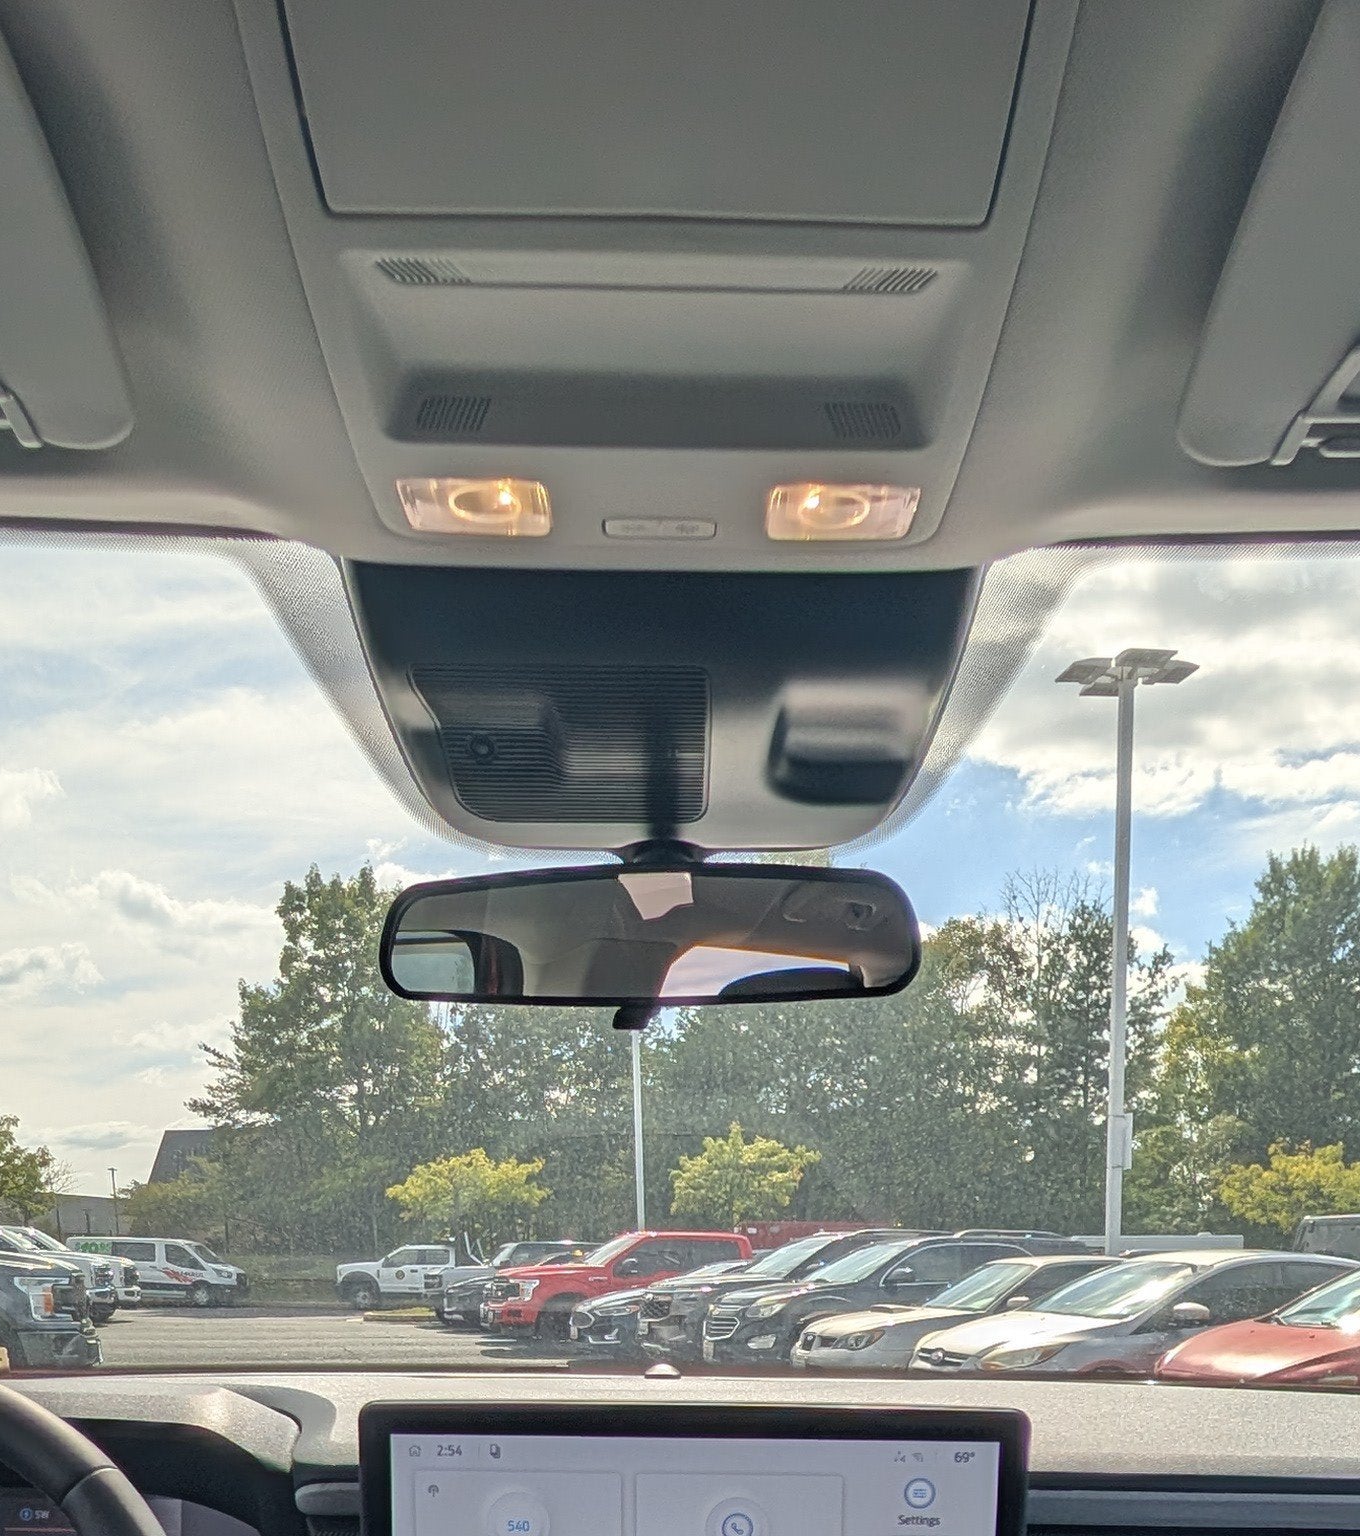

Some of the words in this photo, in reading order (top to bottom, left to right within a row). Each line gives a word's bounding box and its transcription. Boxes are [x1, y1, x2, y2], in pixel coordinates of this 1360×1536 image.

[437, 1444, 463, 1457] 2:54
[507, 1519, 531, 1532] 540
[897, 1514, 941, 1527] Settings
